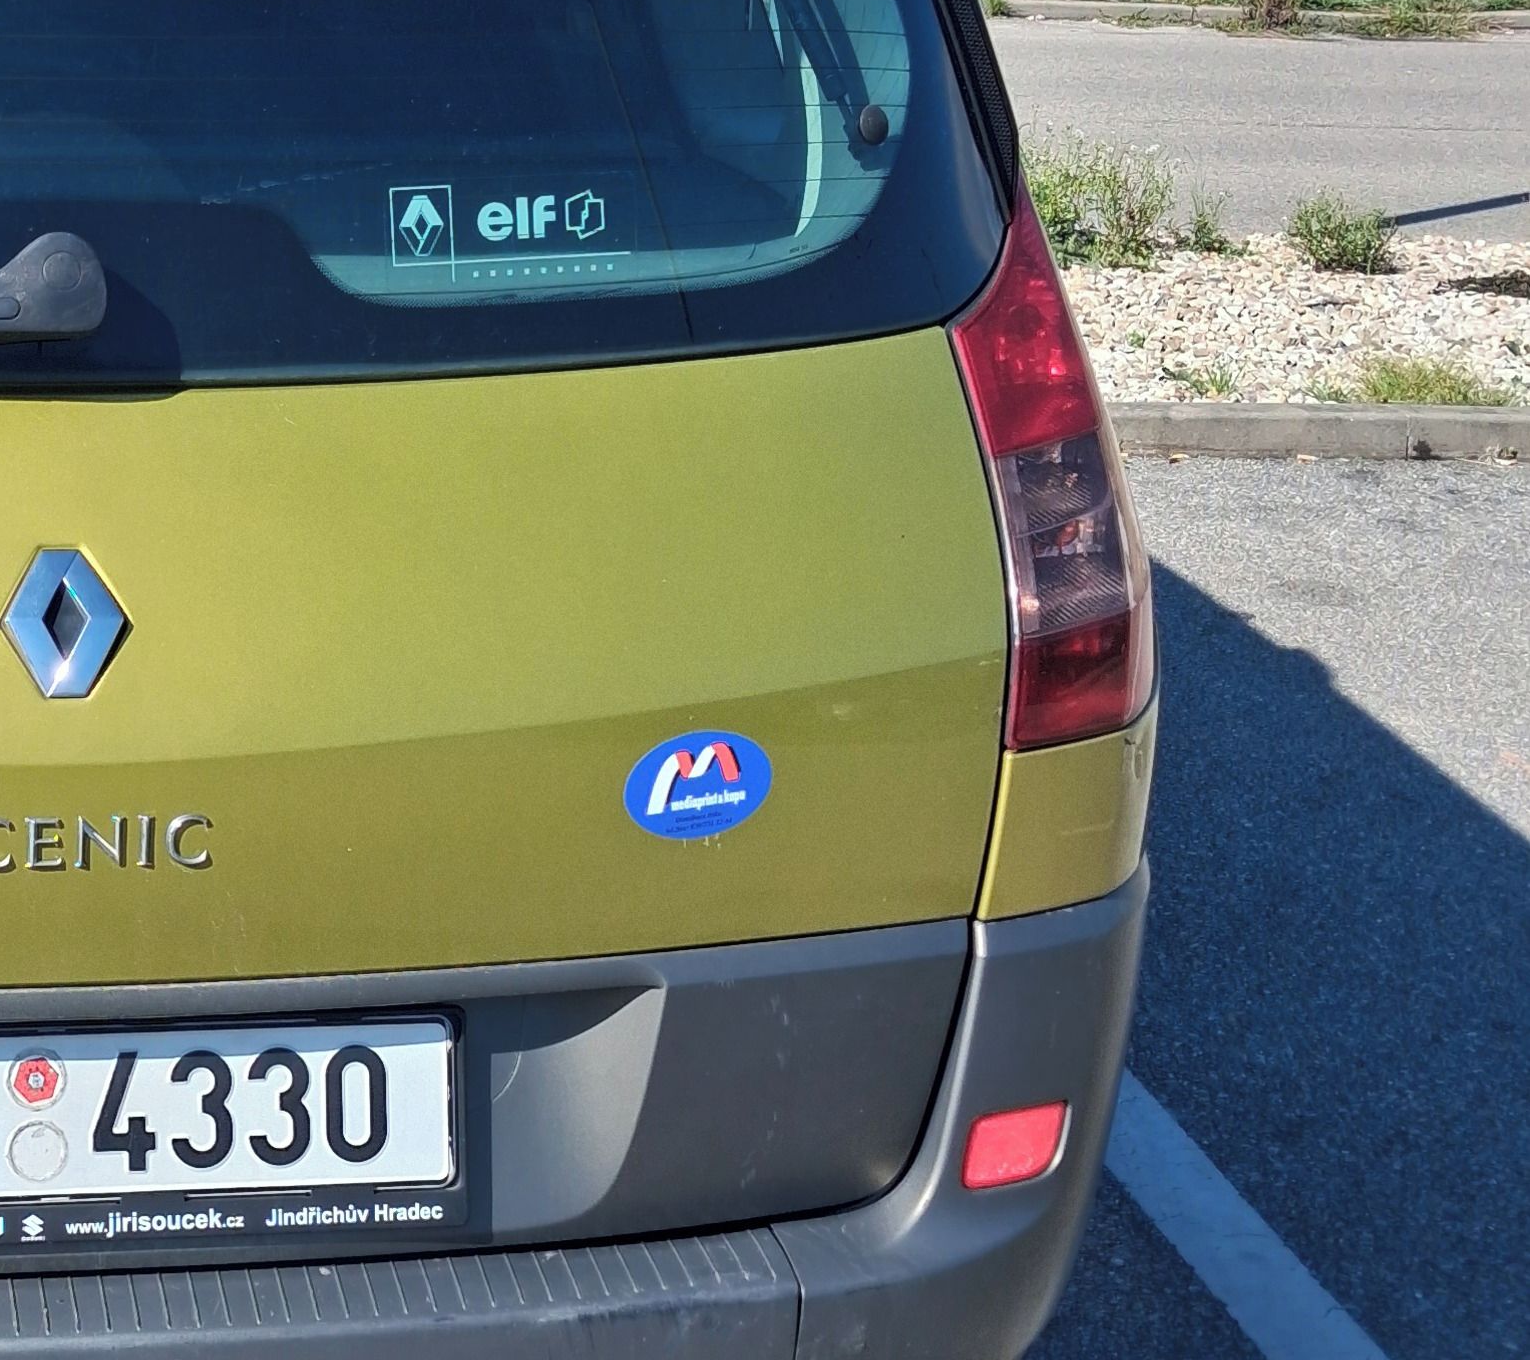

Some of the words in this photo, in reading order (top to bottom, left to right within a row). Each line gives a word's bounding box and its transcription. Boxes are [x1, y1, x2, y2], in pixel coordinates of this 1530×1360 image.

[476, 194, 557, 241] elf
[92, 1044, 391, 1174] 4330
[65, 1207, 245, 1238] www.jirisoucek.cz
[265, 1204, 370, 1228] Jindřichův
[373, 1202, 444, 1223] Hradec
